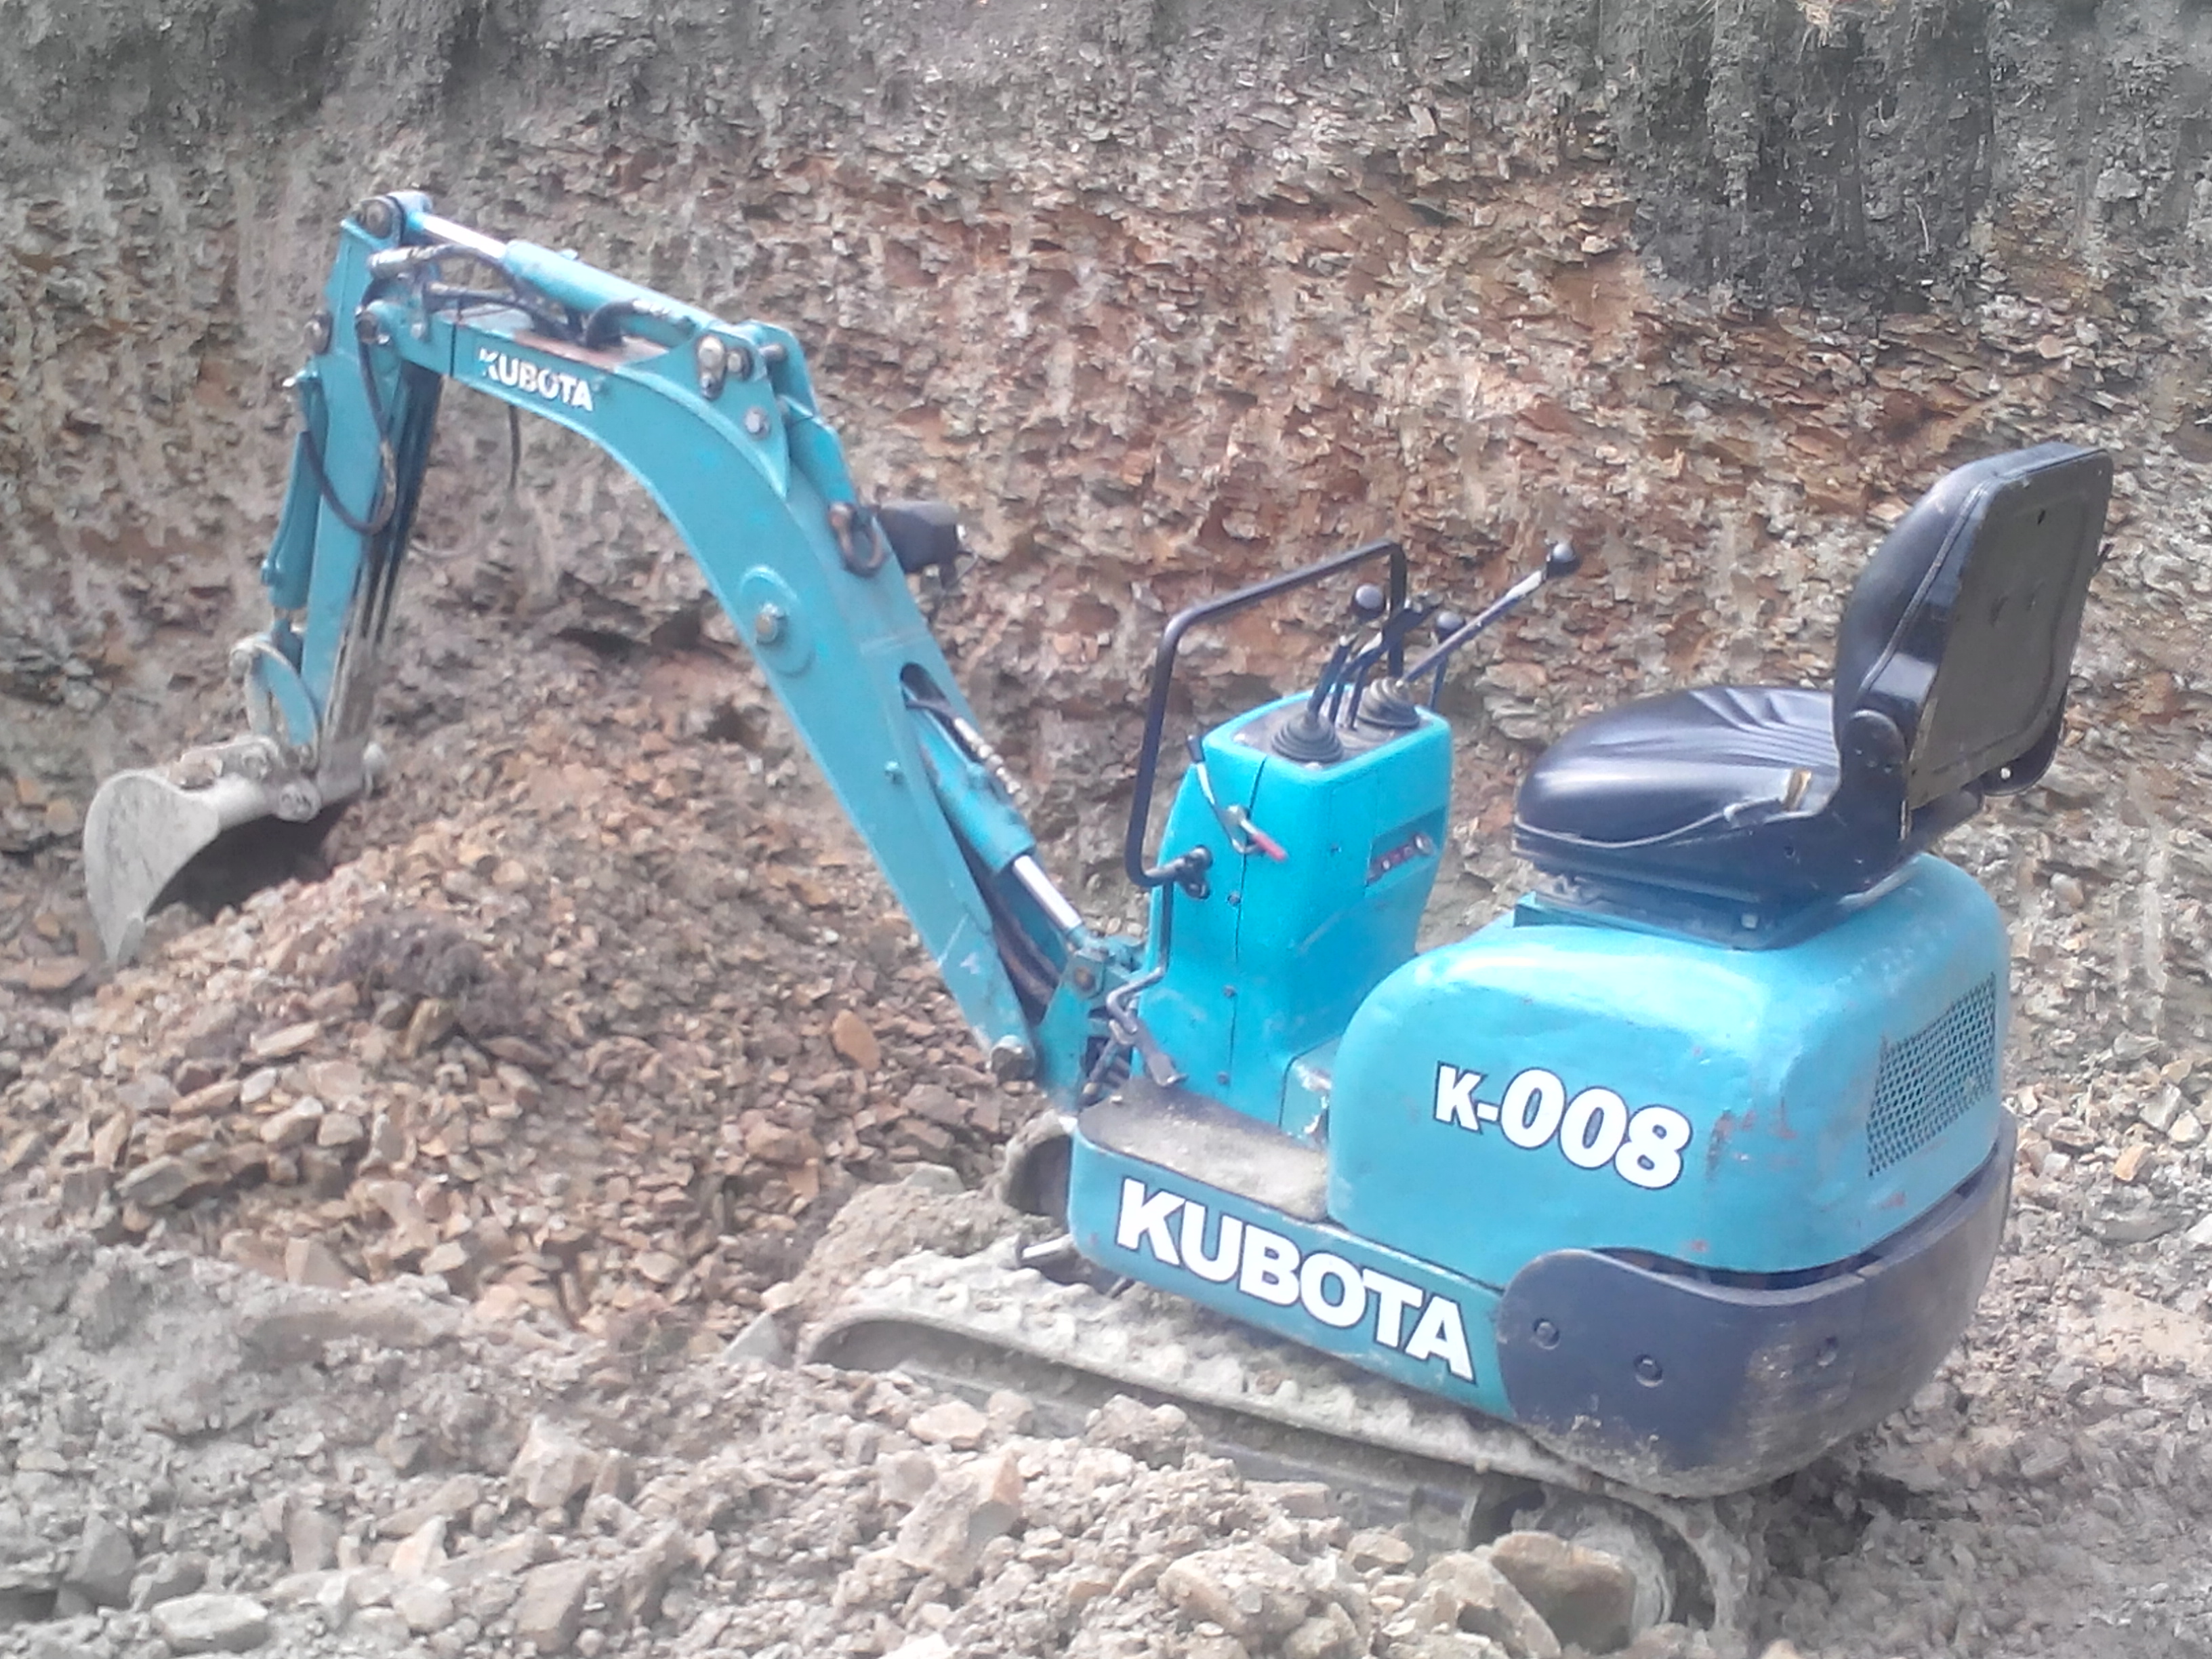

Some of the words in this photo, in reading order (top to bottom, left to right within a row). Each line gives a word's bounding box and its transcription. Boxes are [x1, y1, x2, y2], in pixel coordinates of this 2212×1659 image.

[478, 347, 594, 412] KUBOTA
[1433, 1061, 1693, 1190] K-008
[1115, 1176, 1477, 1385] KUBOTA
